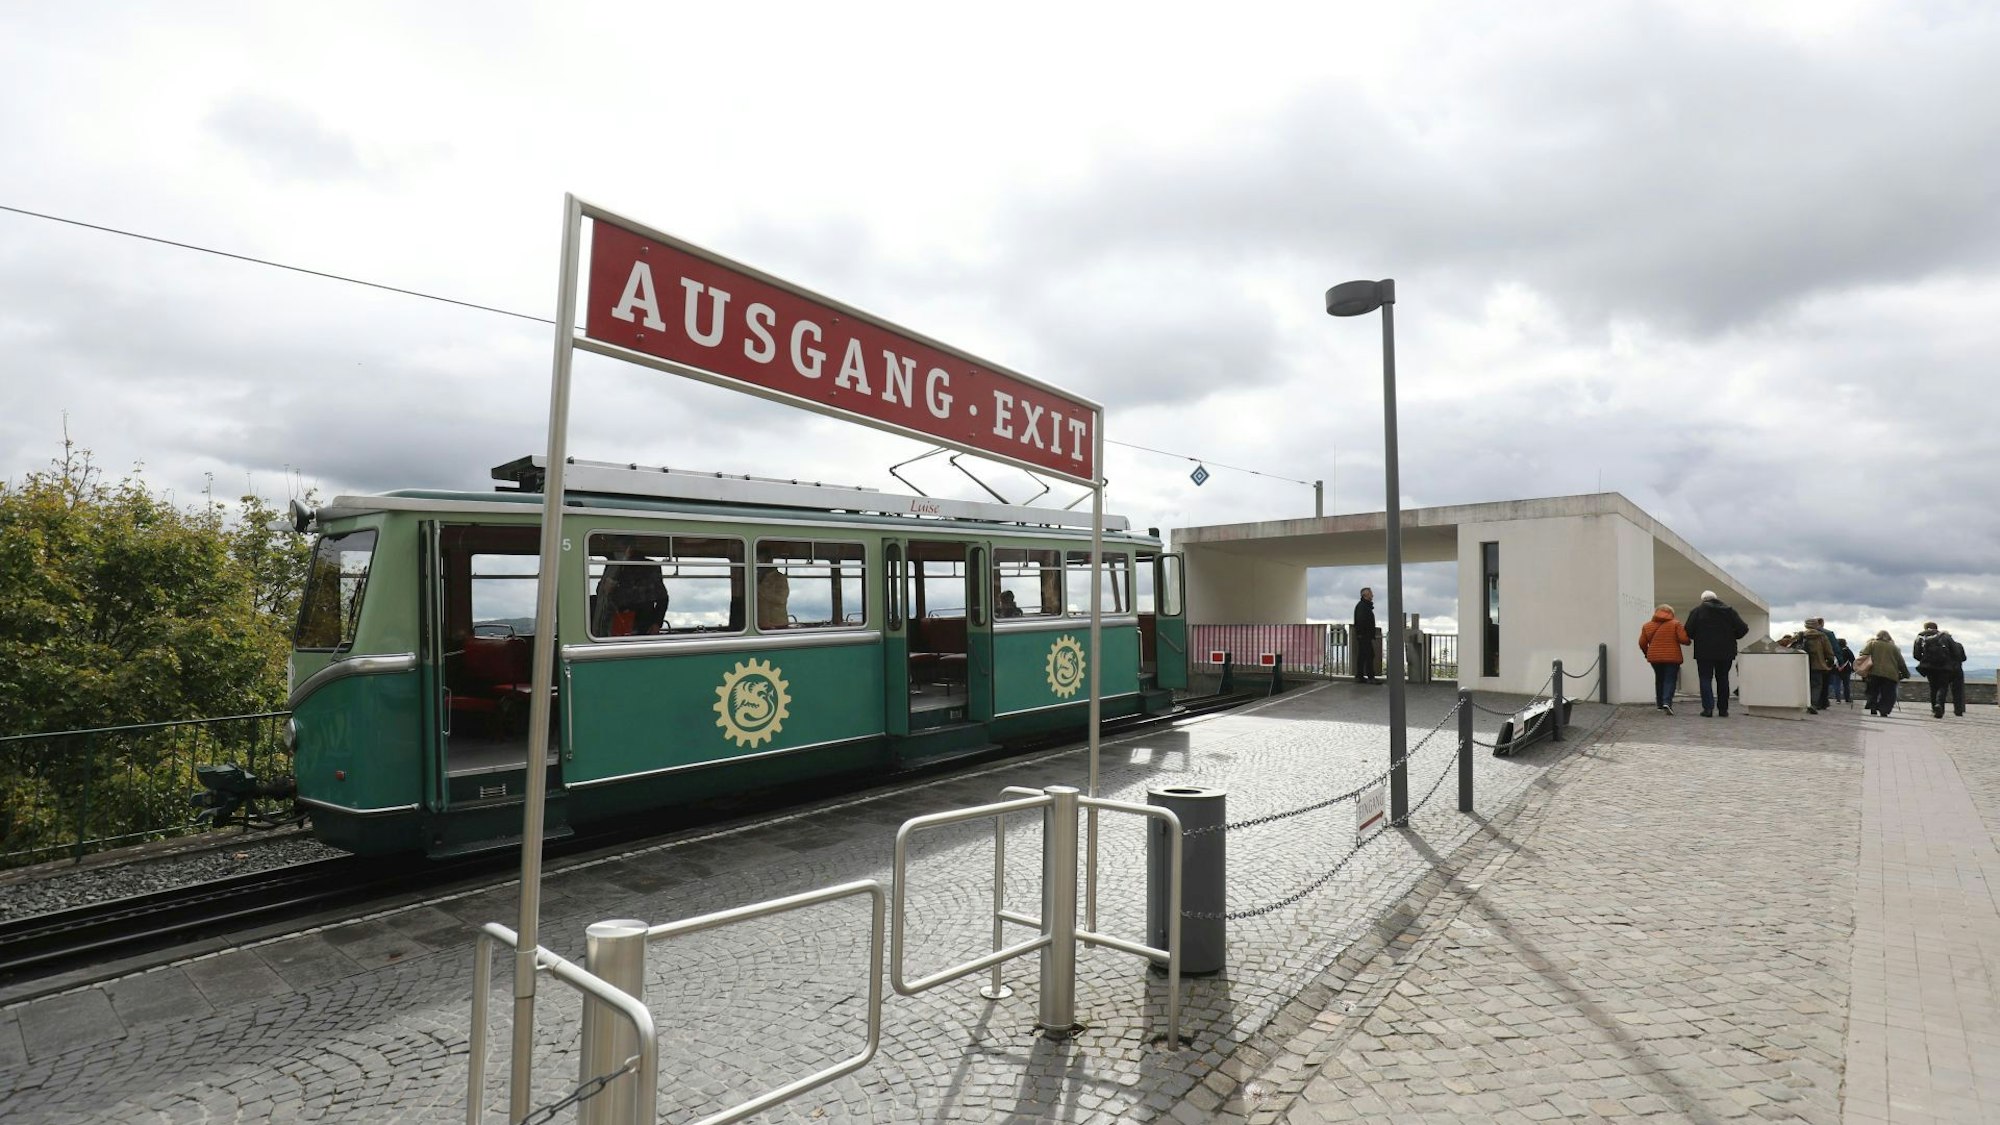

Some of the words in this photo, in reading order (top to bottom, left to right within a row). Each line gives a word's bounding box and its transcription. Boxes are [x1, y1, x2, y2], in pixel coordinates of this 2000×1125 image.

[611, 260, 954, 420] AUSGANG
[992, 390, 1086, 462] EXIT
[910, 499, 940, 514] Luise
[562, 538, 572, 552] 5
[1358, 792, 1384, 820] EINGANG
